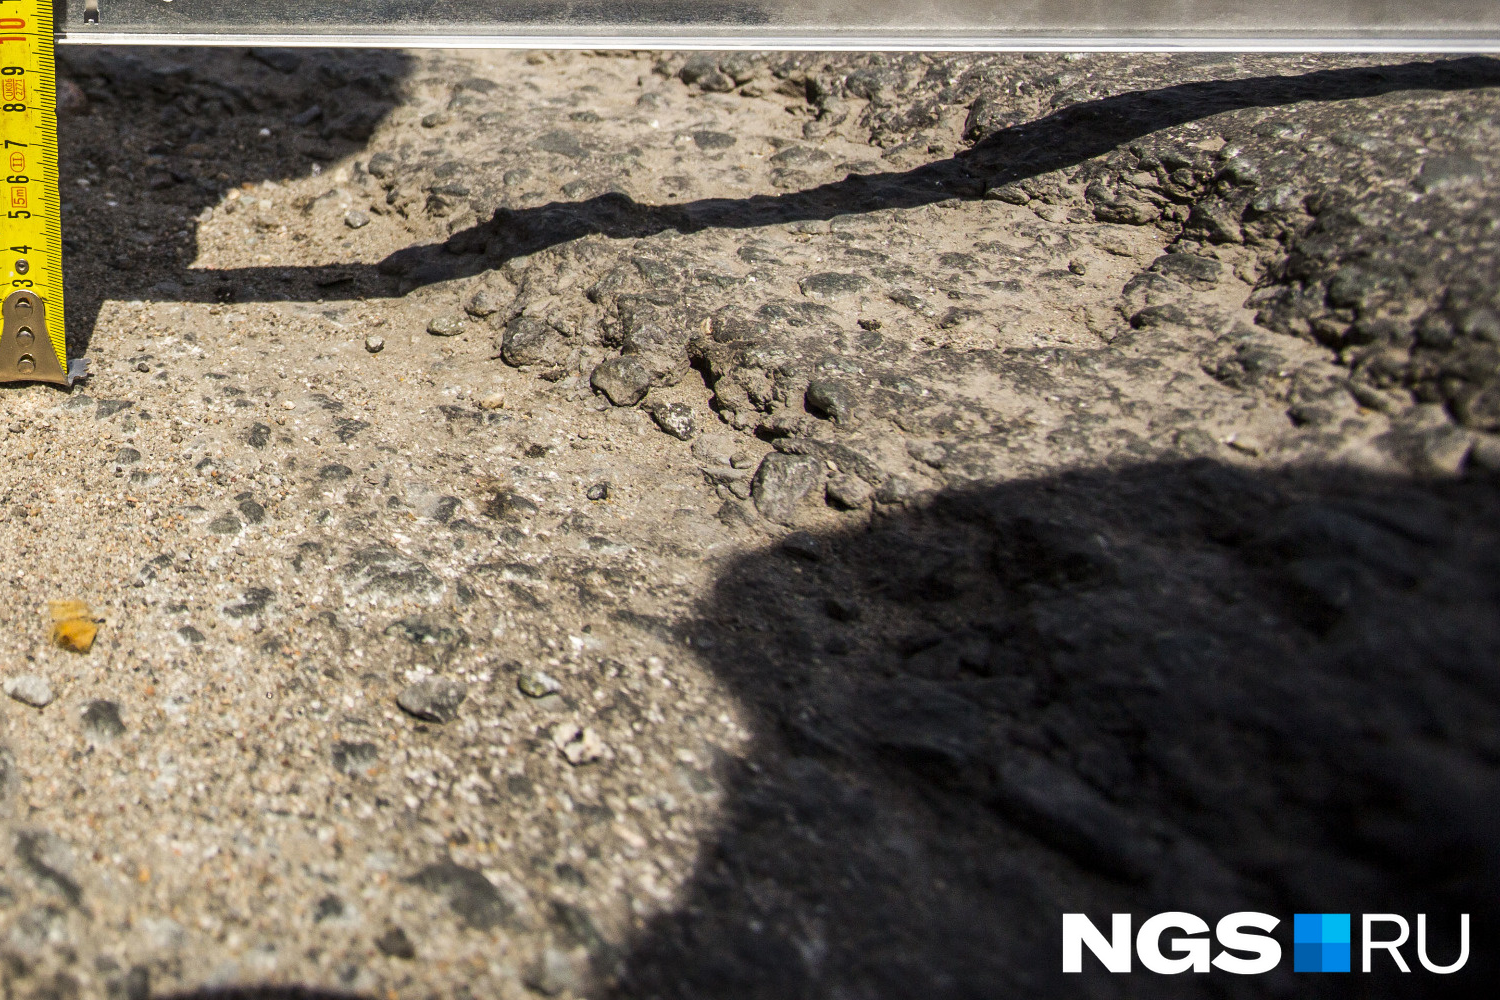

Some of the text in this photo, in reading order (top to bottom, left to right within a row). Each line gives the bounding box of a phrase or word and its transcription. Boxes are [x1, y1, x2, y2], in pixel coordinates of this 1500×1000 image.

[1, 66, 25, 76] 9
[2, 103, 26, 112] 8
[4, 139, 28, 149] 7
[6, 175, 30, 184] 6
[13, 188, 26, 206] 5m
[8, 210, 32, 219] 5
[10, 245, 33, 254] 4
[12, 279, 34, 288] 3
